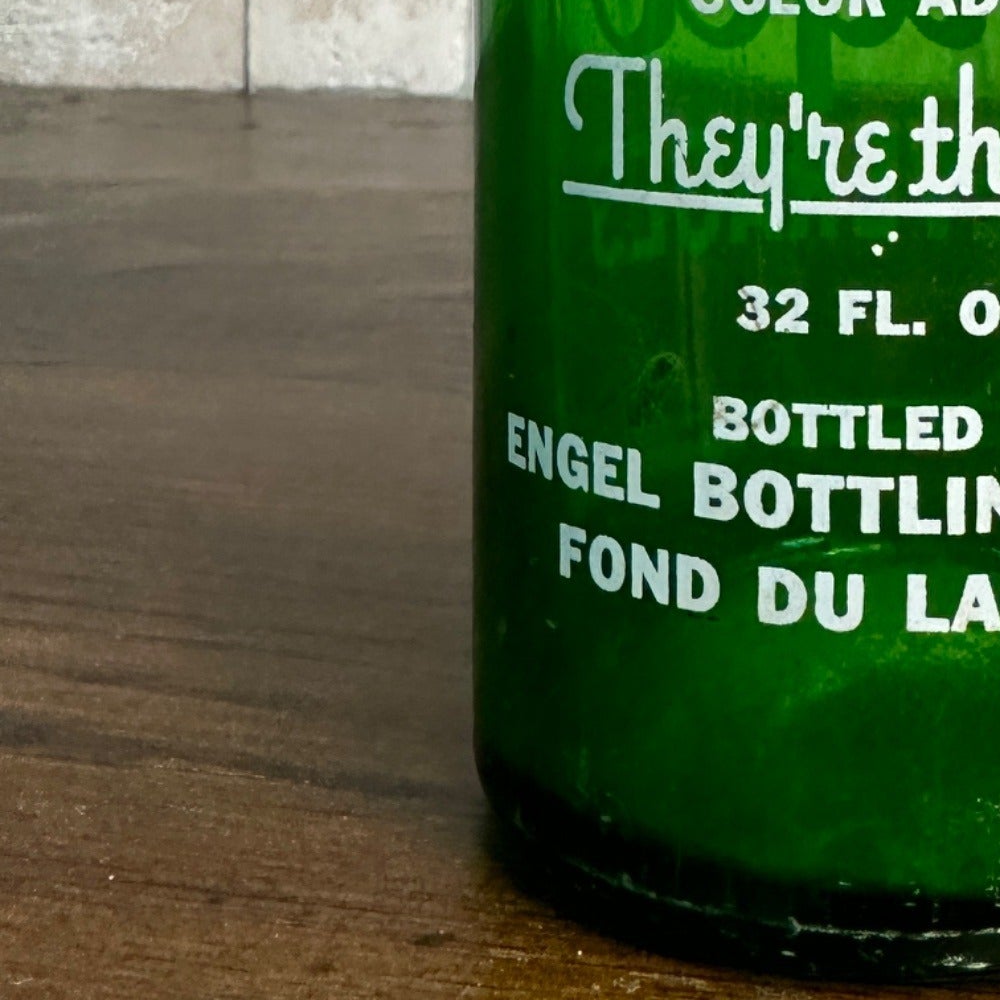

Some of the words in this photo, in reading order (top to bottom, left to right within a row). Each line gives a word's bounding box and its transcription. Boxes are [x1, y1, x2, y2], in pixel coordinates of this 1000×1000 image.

[564, 55, 898, 232] They're
[737, 286, 809, 333] 32
[839, 290, 926, 335] FL.
[507, 411, 661, 510] ENGEL
[713, 396, 983, 451] BOTTLED
[559, 523, 721, 613] FOND
[758, 566, 864, 632] DU
